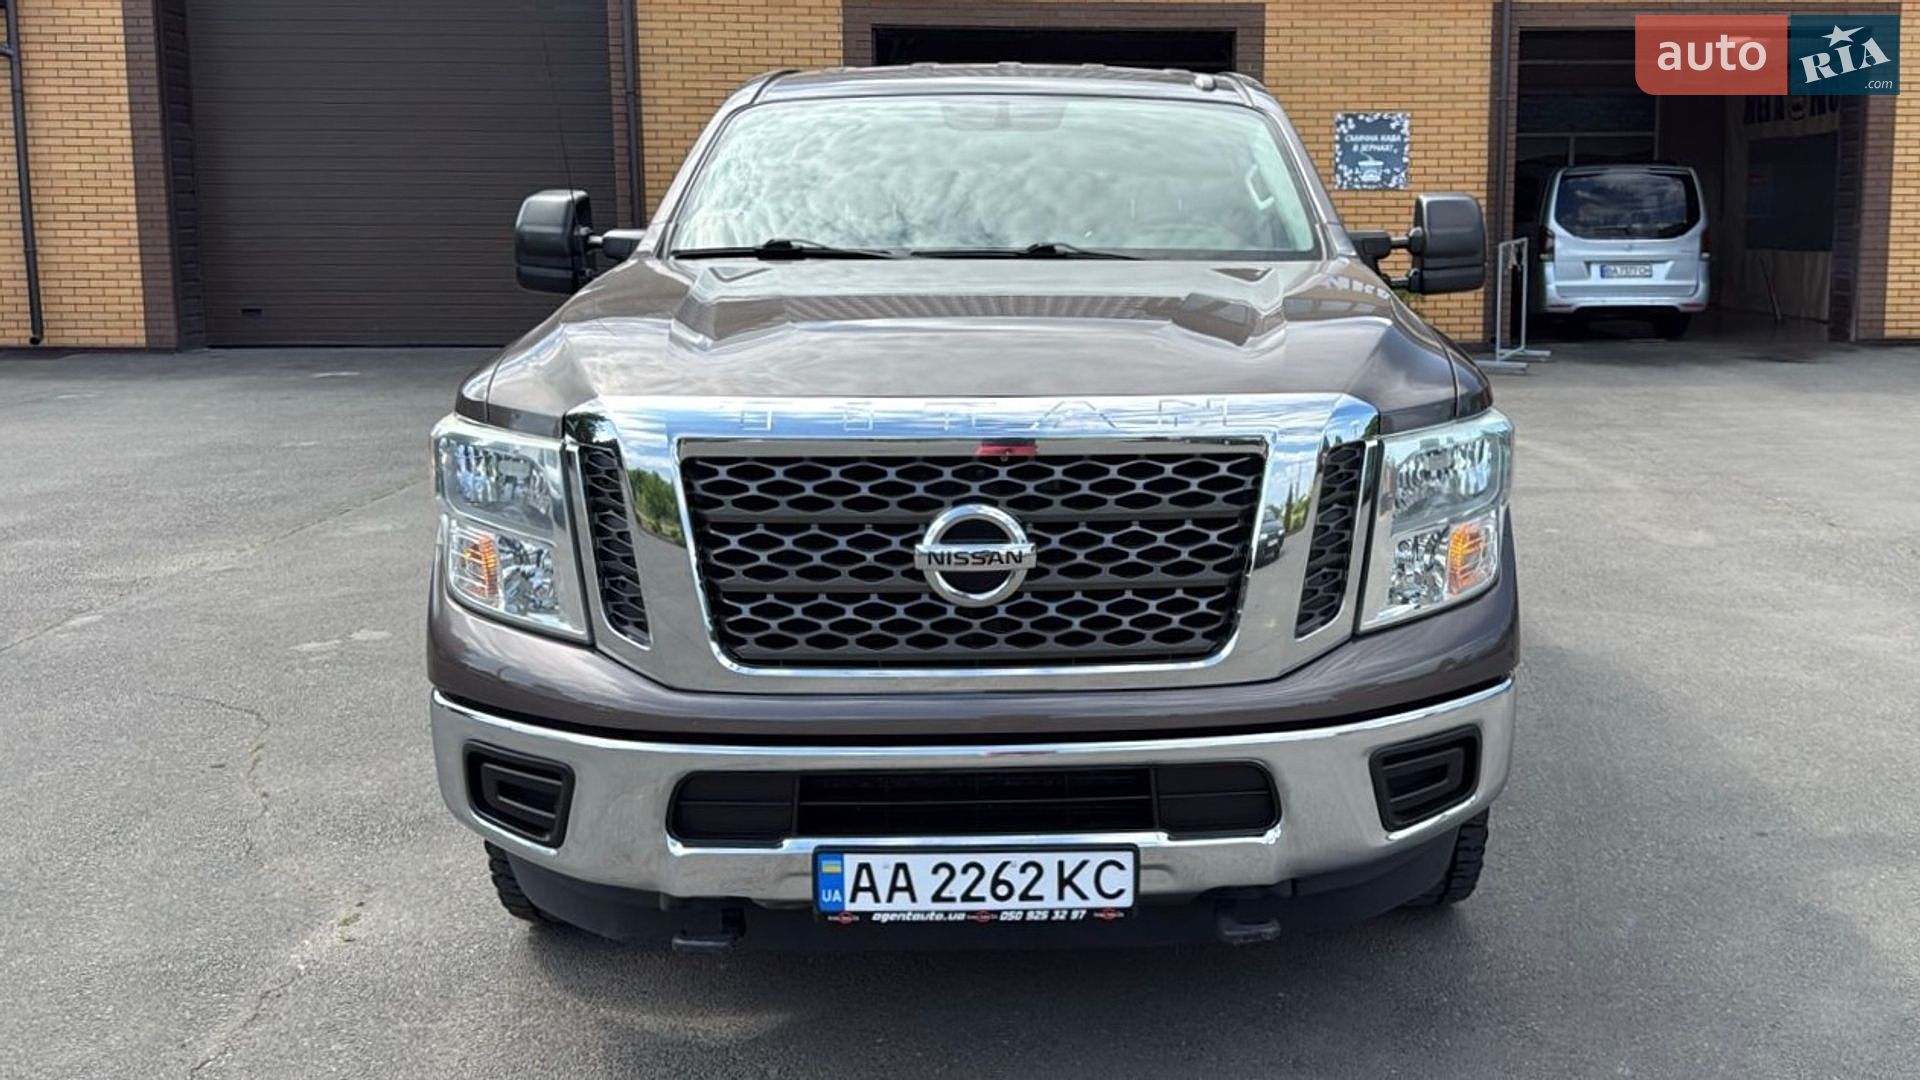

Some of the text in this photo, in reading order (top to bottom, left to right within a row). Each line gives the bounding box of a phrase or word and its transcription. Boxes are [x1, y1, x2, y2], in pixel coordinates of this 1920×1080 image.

[927, 550, 1023, 566] NISSAN
[848, 858, 1127, 903] AA 2262 KC
[822, 889, 842, 902] UA
[872, 911, 966, 923] agentauto.ua
[1000, 910, 1023, 921] 050
[1051, 910, 1067, 920] 32
